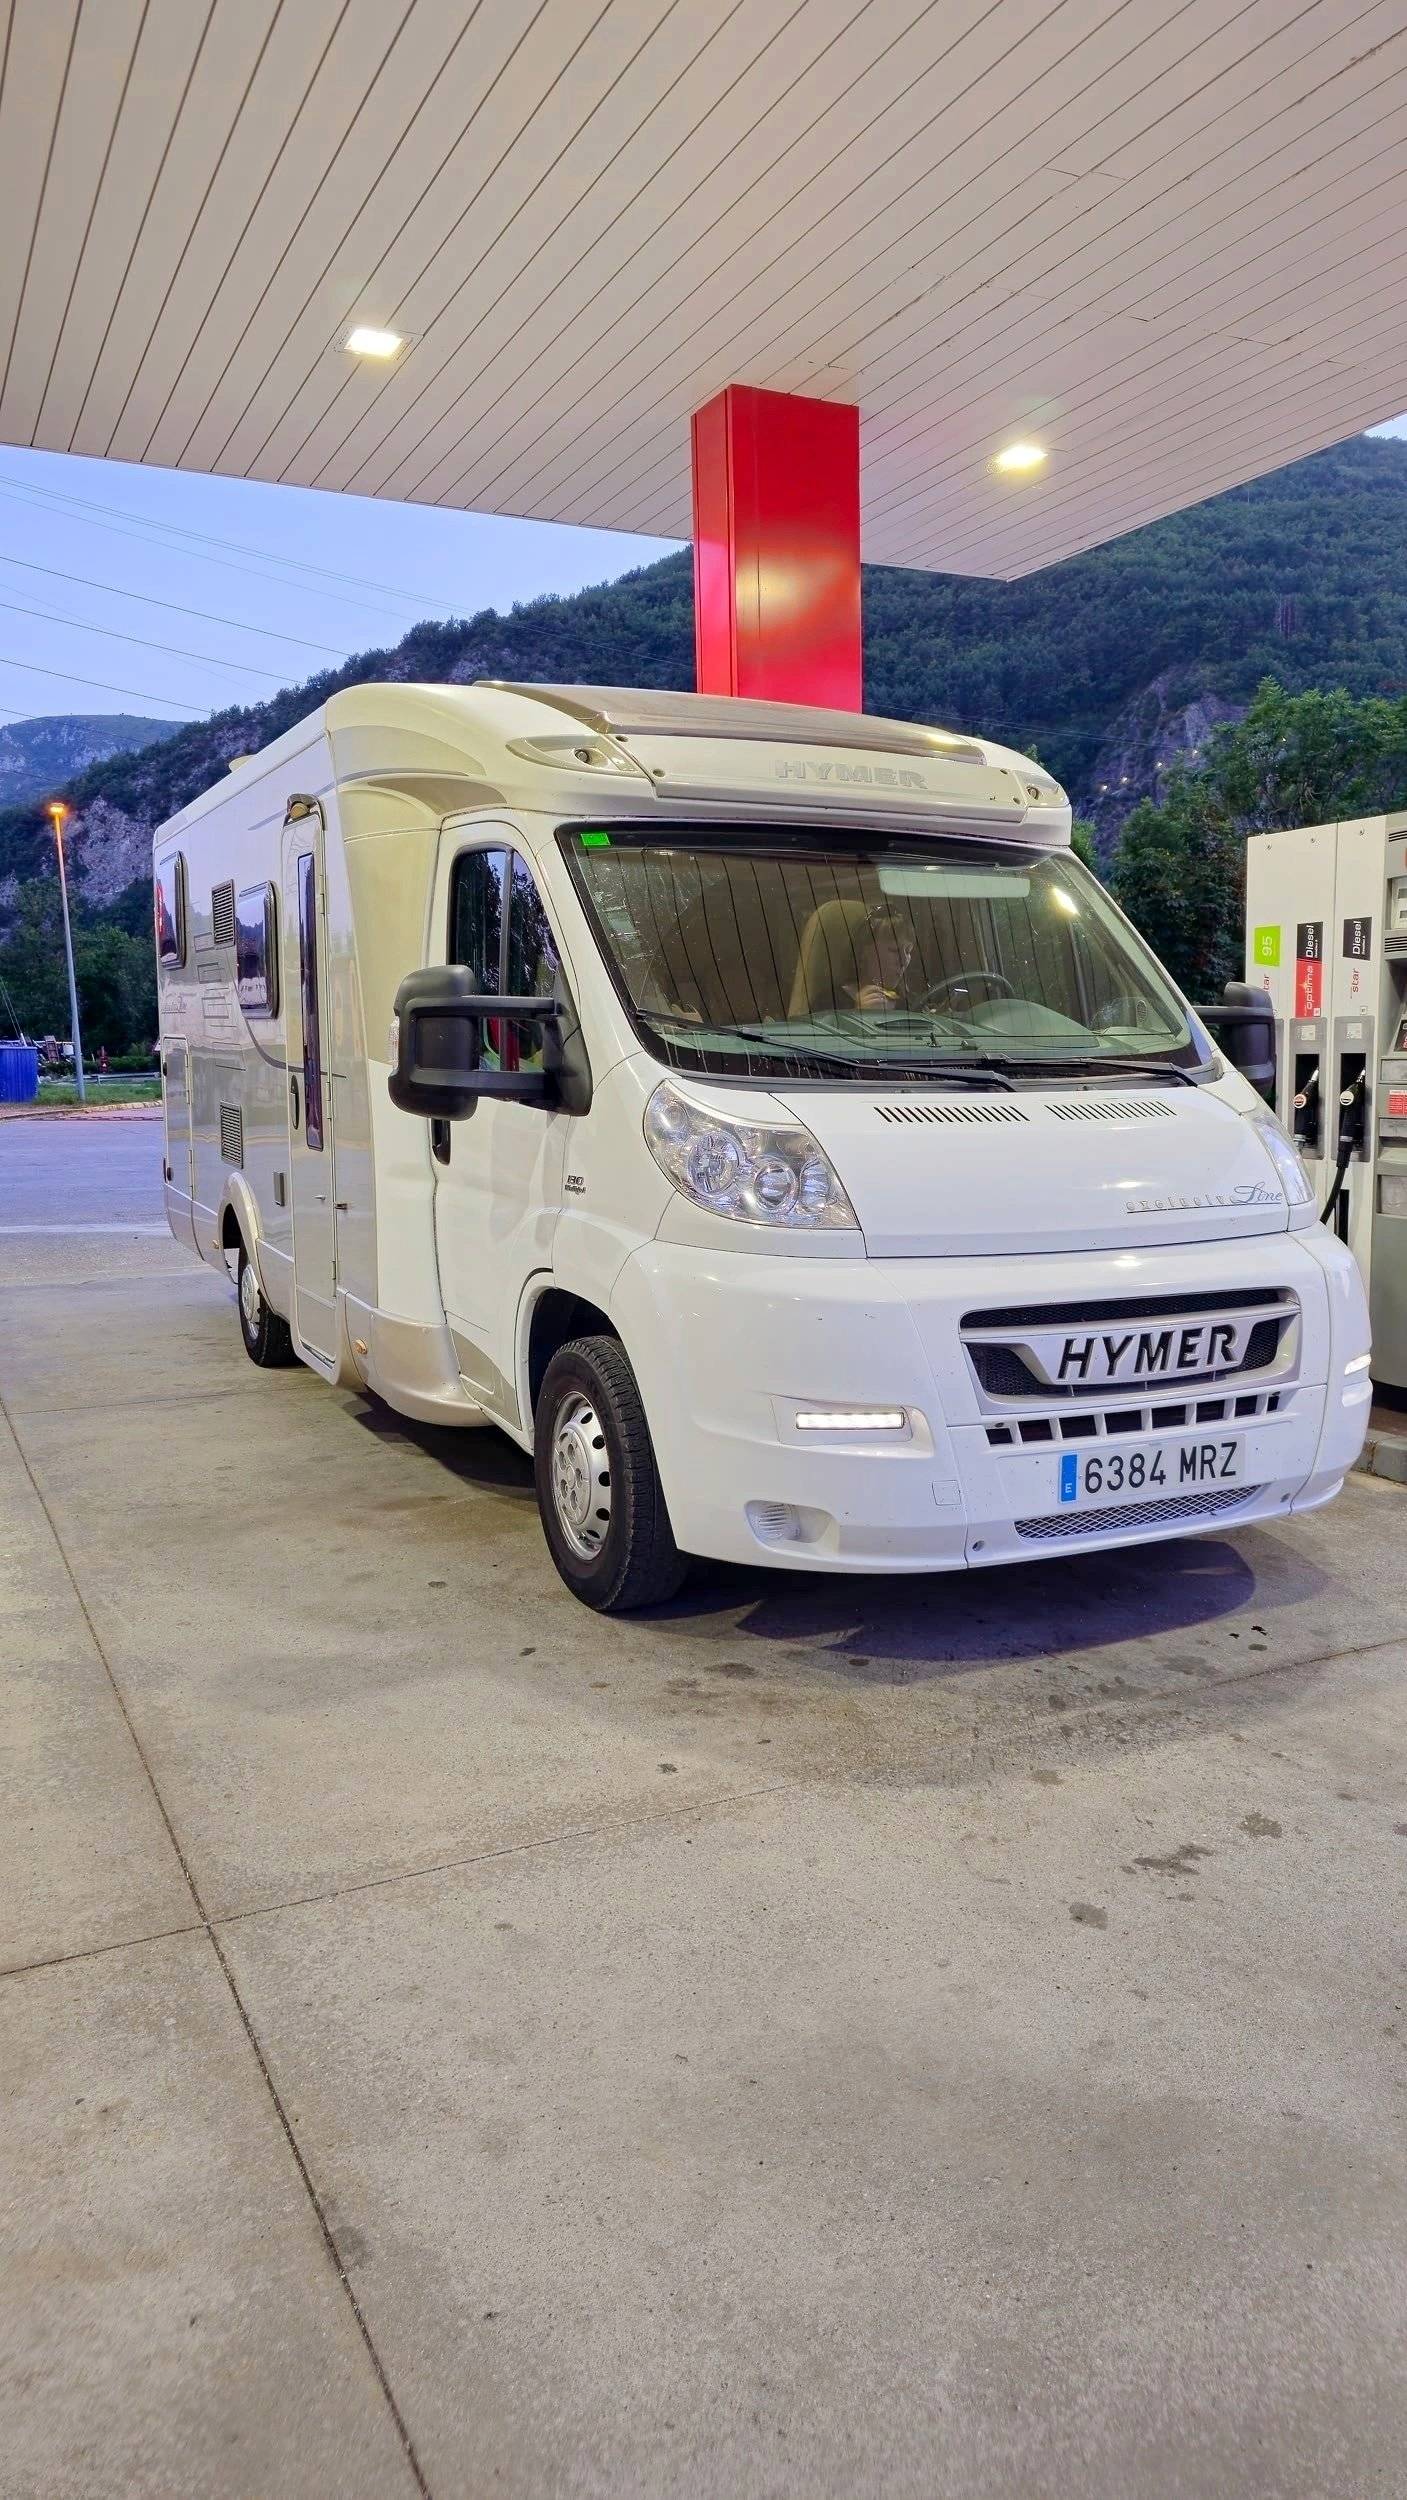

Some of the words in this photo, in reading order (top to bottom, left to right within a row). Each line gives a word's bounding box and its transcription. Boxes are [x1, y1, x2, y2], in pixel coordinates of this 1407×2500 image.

[773, 760, 929, 789] HYMER
[1262, 936, 1272, 957] 95
[1305, 924, 1314, 958] Diesel
[1353, 921, 1362, 955] Diesel
[1352, 968, 1360, 993] star
[1057, 1324, 1243, 1381] HYMER
[1084, 1449, 1166, 1494] 6384
[1179, 1441, 1237, 1483] MRZ
[1065, 1482, 1073, 1493] E
